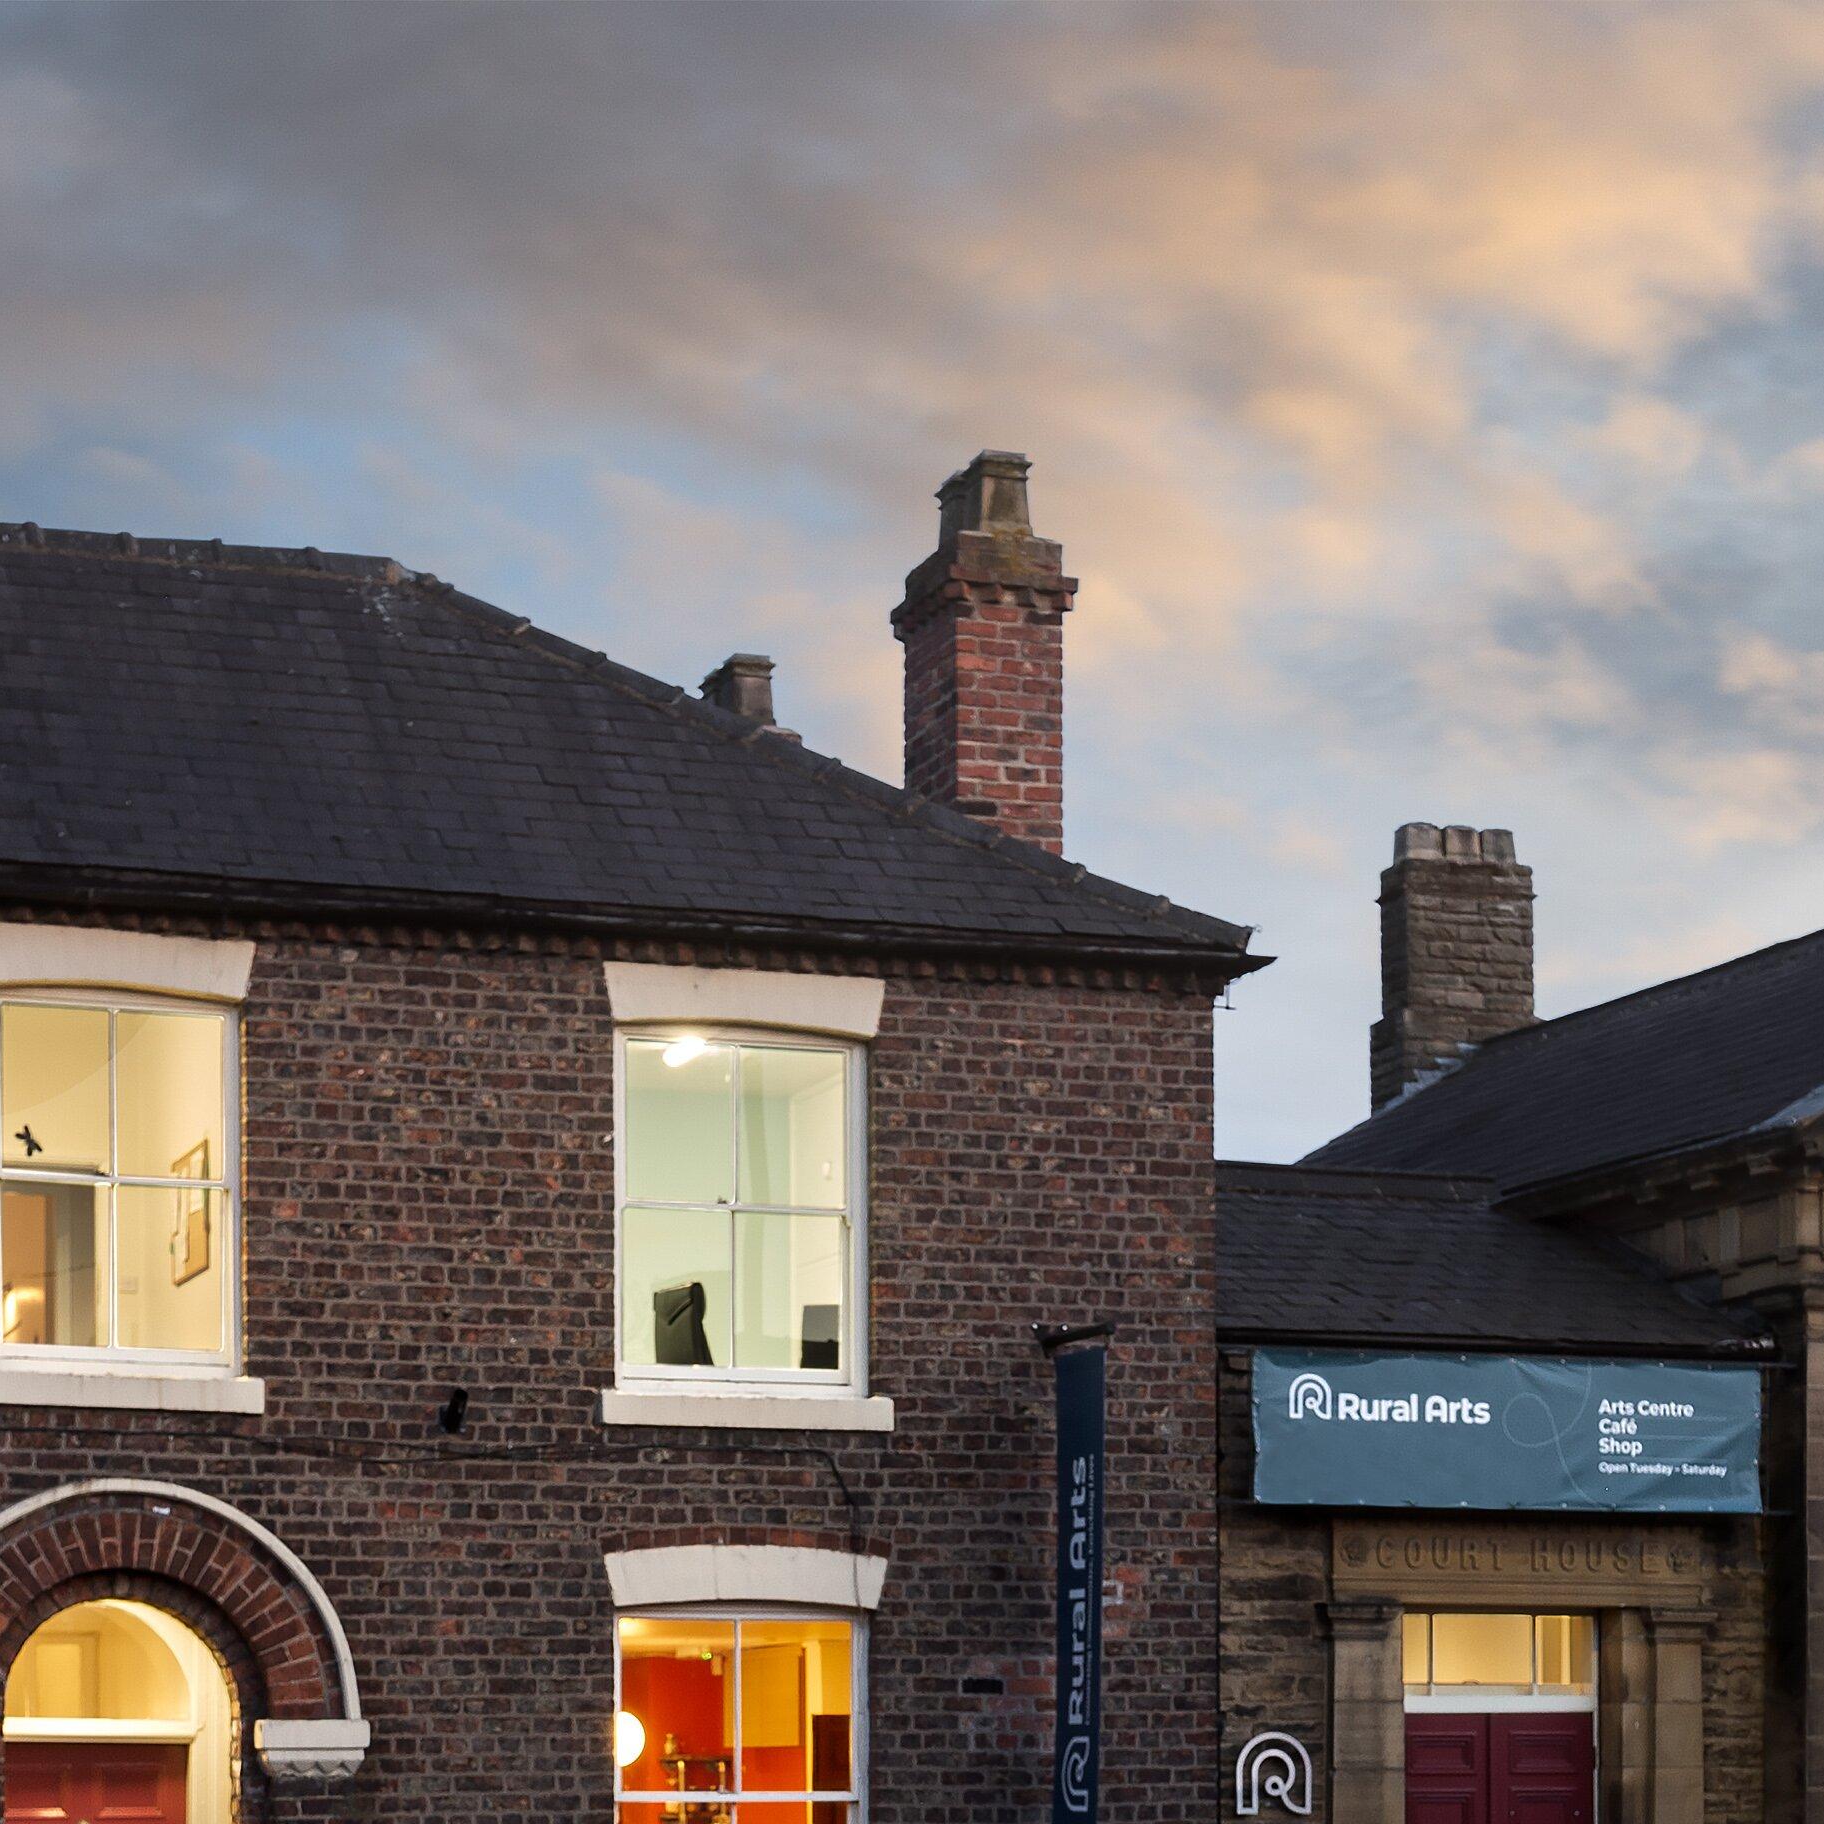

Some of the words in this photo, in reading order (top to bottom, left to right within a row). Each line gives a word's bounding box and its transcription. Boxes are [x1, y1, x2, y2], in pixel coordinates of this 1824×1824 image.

[1337, 1392, 1419, 1423] Rural
[1424, 1394, 1491, 1425] Arts
[1598, 1399, 1635, 1417] Arts
[1637, 1399, 1695, 1418] Centre
[1598, 1418, 1638, 1436] Café
[1598, 1437, 1643, 1457] Shop
[1598, 1461, 1629, 1474] Open
[1630, 1462, 1673, 1477] Tuesday
[1681, 1463, 1727, 1478] Saturday
[1069, 1456, 1087, 1570] Arts
[1376, 1535, 1505, 1572] COURT
[1529, 1537, 1662, 1575] HOUSE
[1069, 1588, 1085, 1725] Rural
